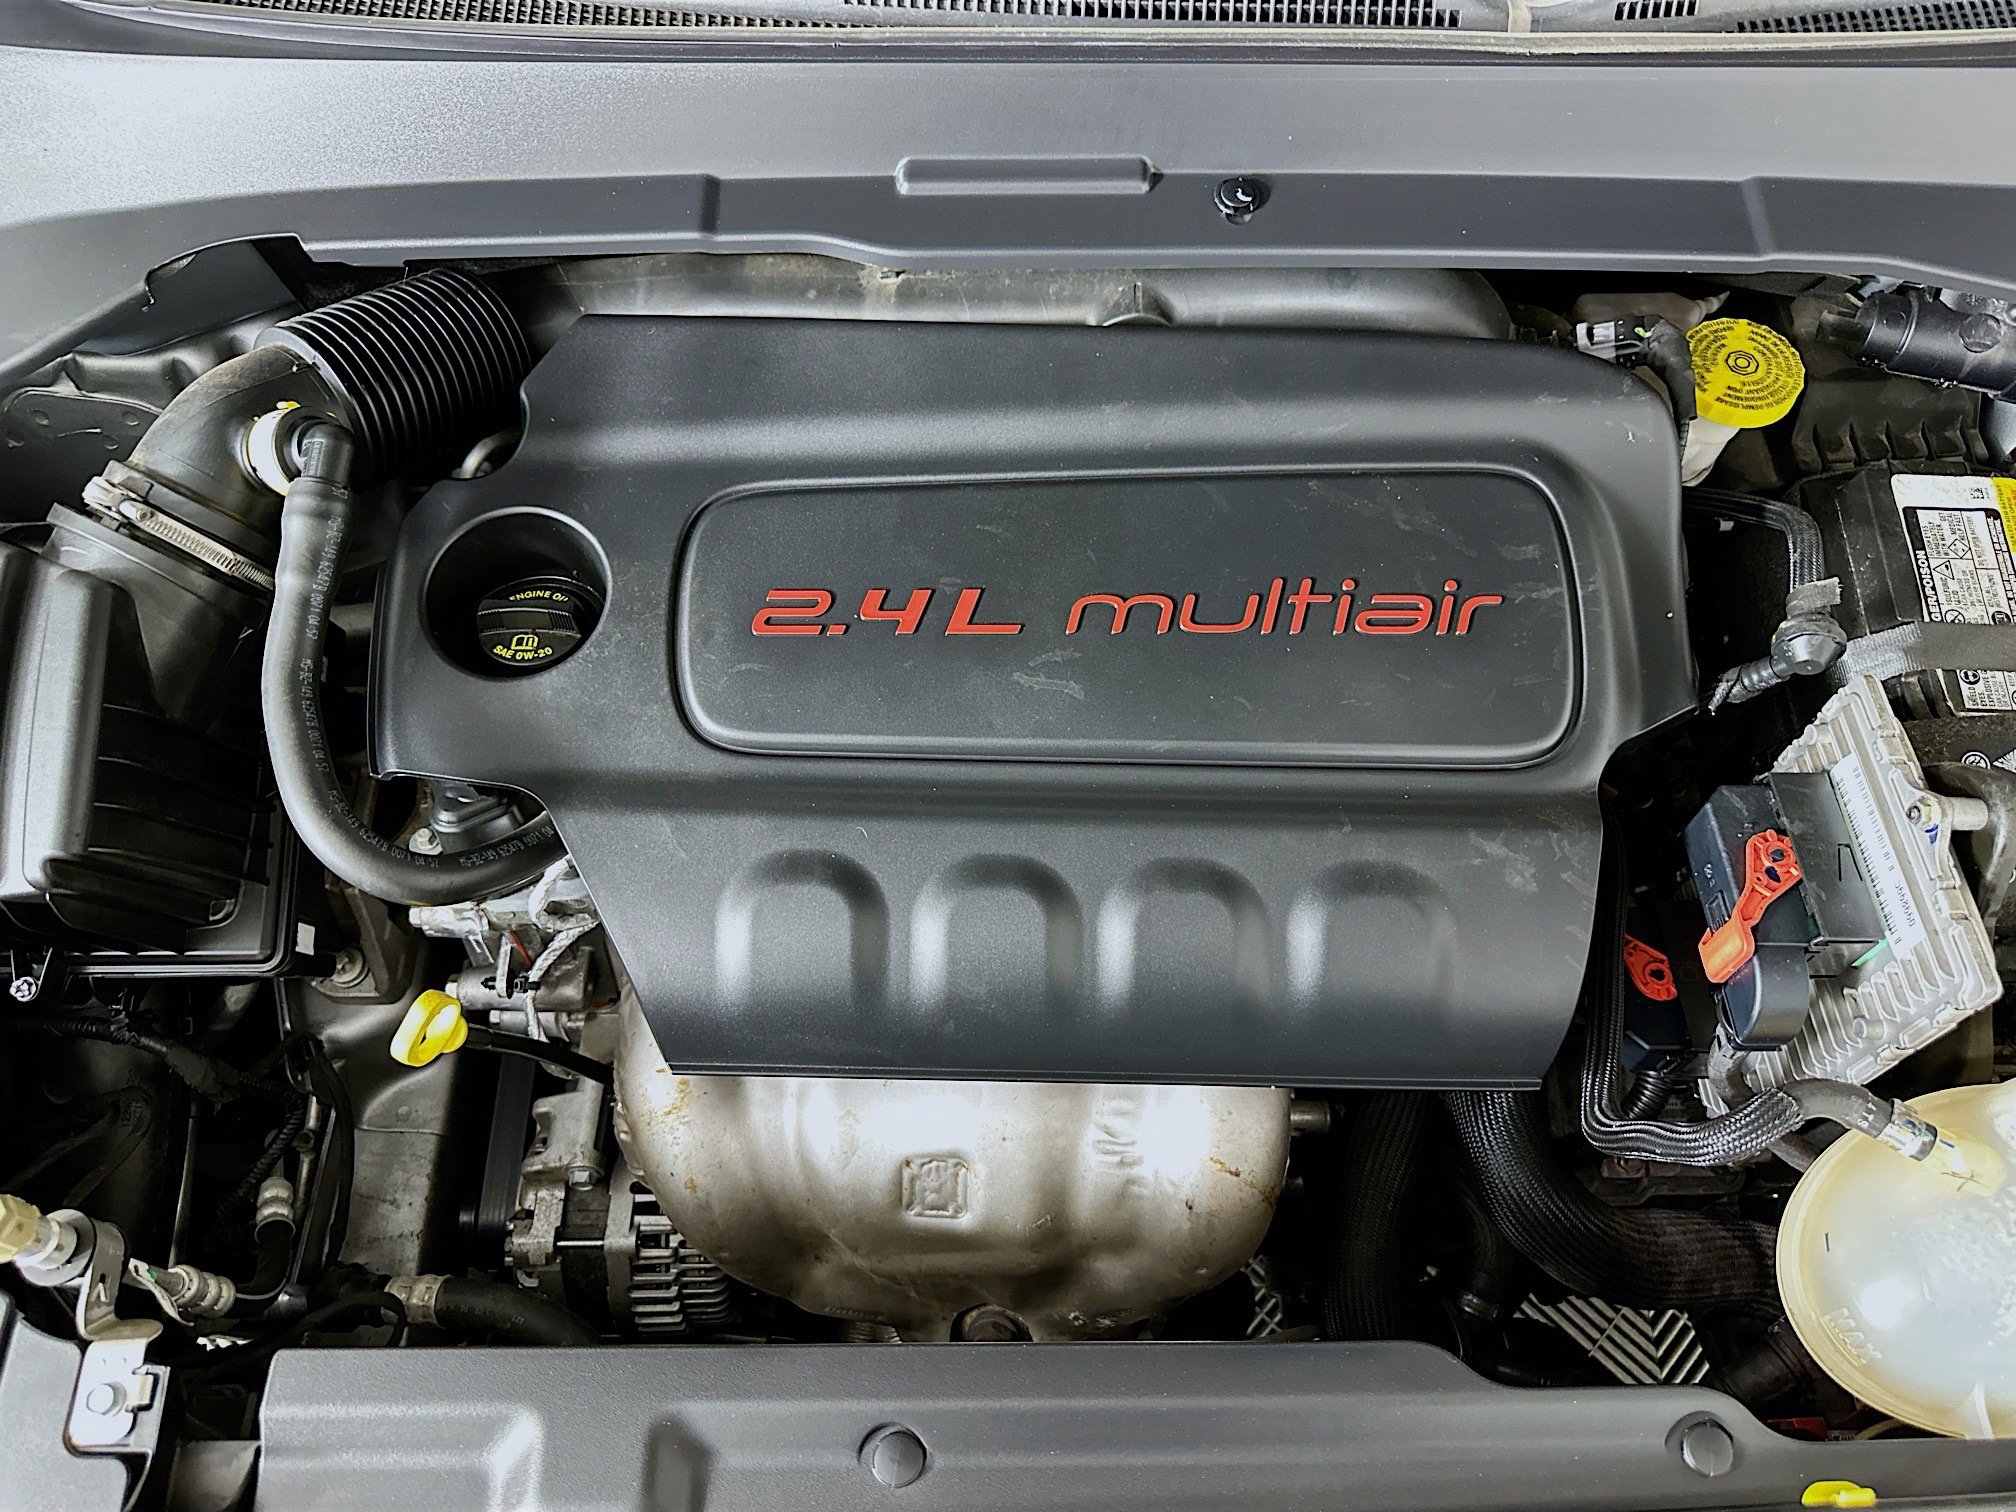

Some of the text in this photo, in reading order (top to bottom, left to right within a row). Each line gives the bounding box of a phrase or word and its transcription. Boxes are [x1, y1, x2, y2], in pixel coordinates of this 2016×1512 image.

[509, 590, 551, 601] ENGINE
[1064, 577, 1503, 636] multiair
[493, 645, 514, 660] SAE
[1822, 1307, 1883, 1364] MAX
